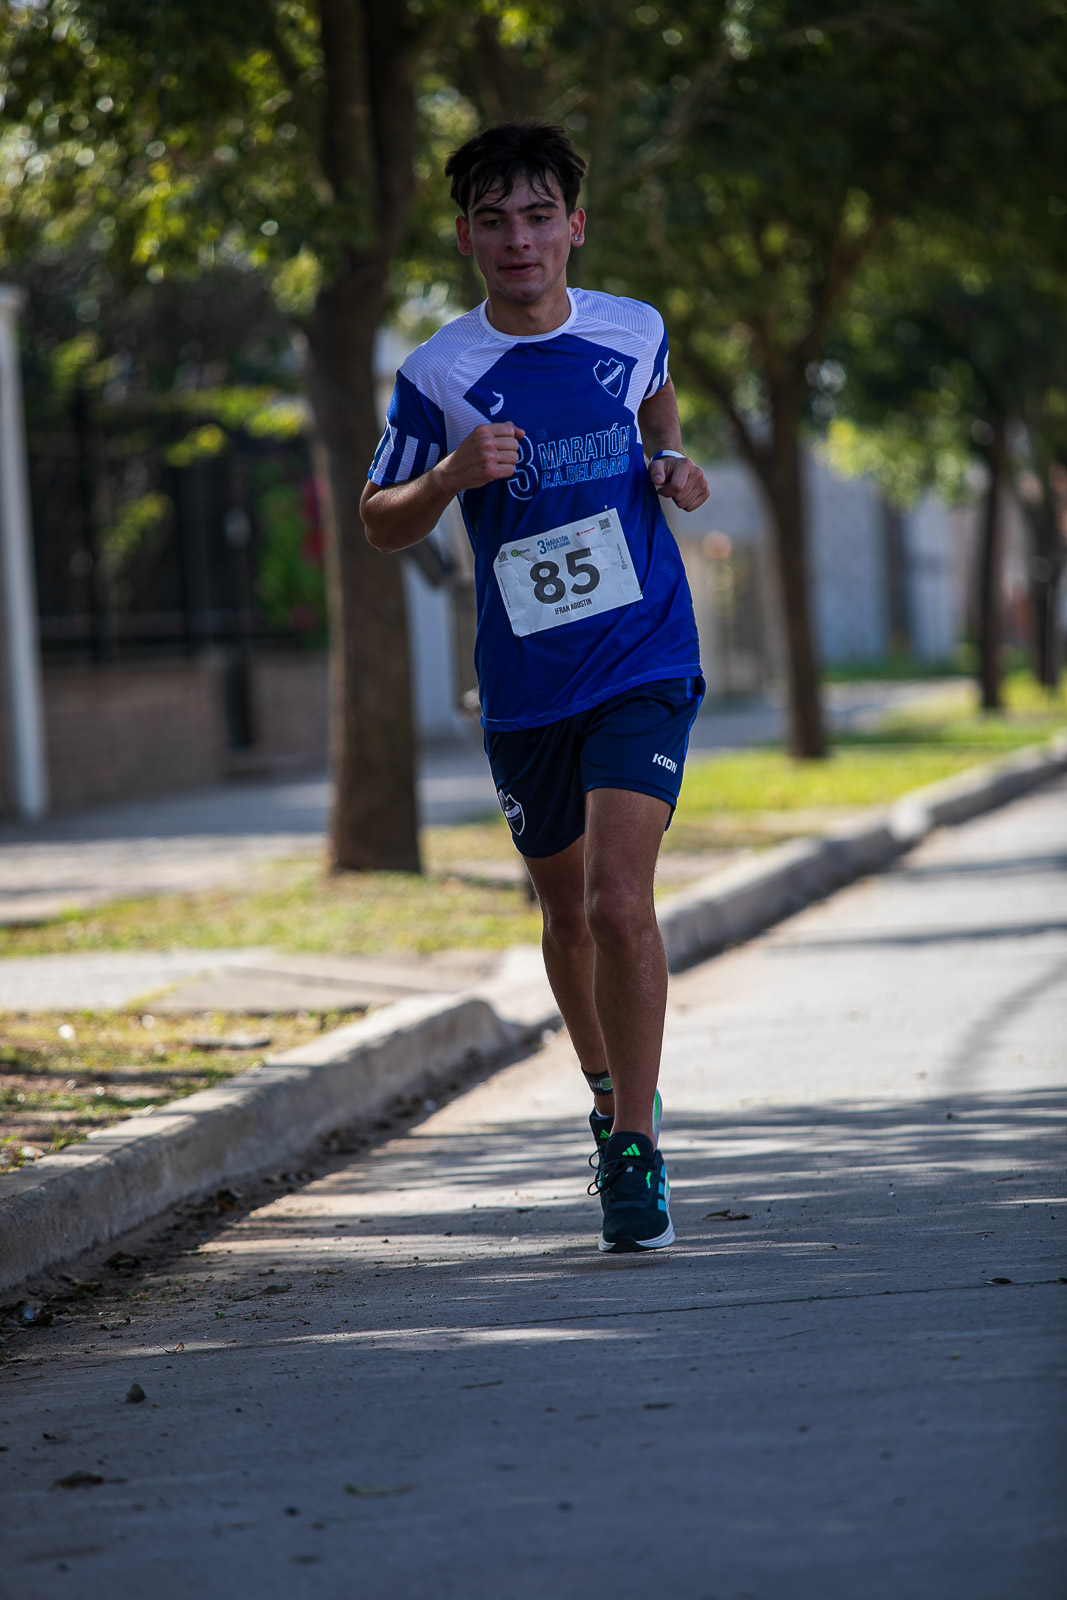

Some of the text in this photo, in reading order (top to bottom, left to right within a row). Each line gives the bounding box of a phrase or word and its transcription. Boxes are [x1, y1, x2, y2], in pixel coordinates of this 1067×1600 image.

[507, 422, 630, 501] 3 MARATÓN
[537, 540, 547, 555] 3
[530, 547, 600, 605] 85
[570, 598, 593, 610] AGUSTIN
[652, 753, 678, 774] KION
